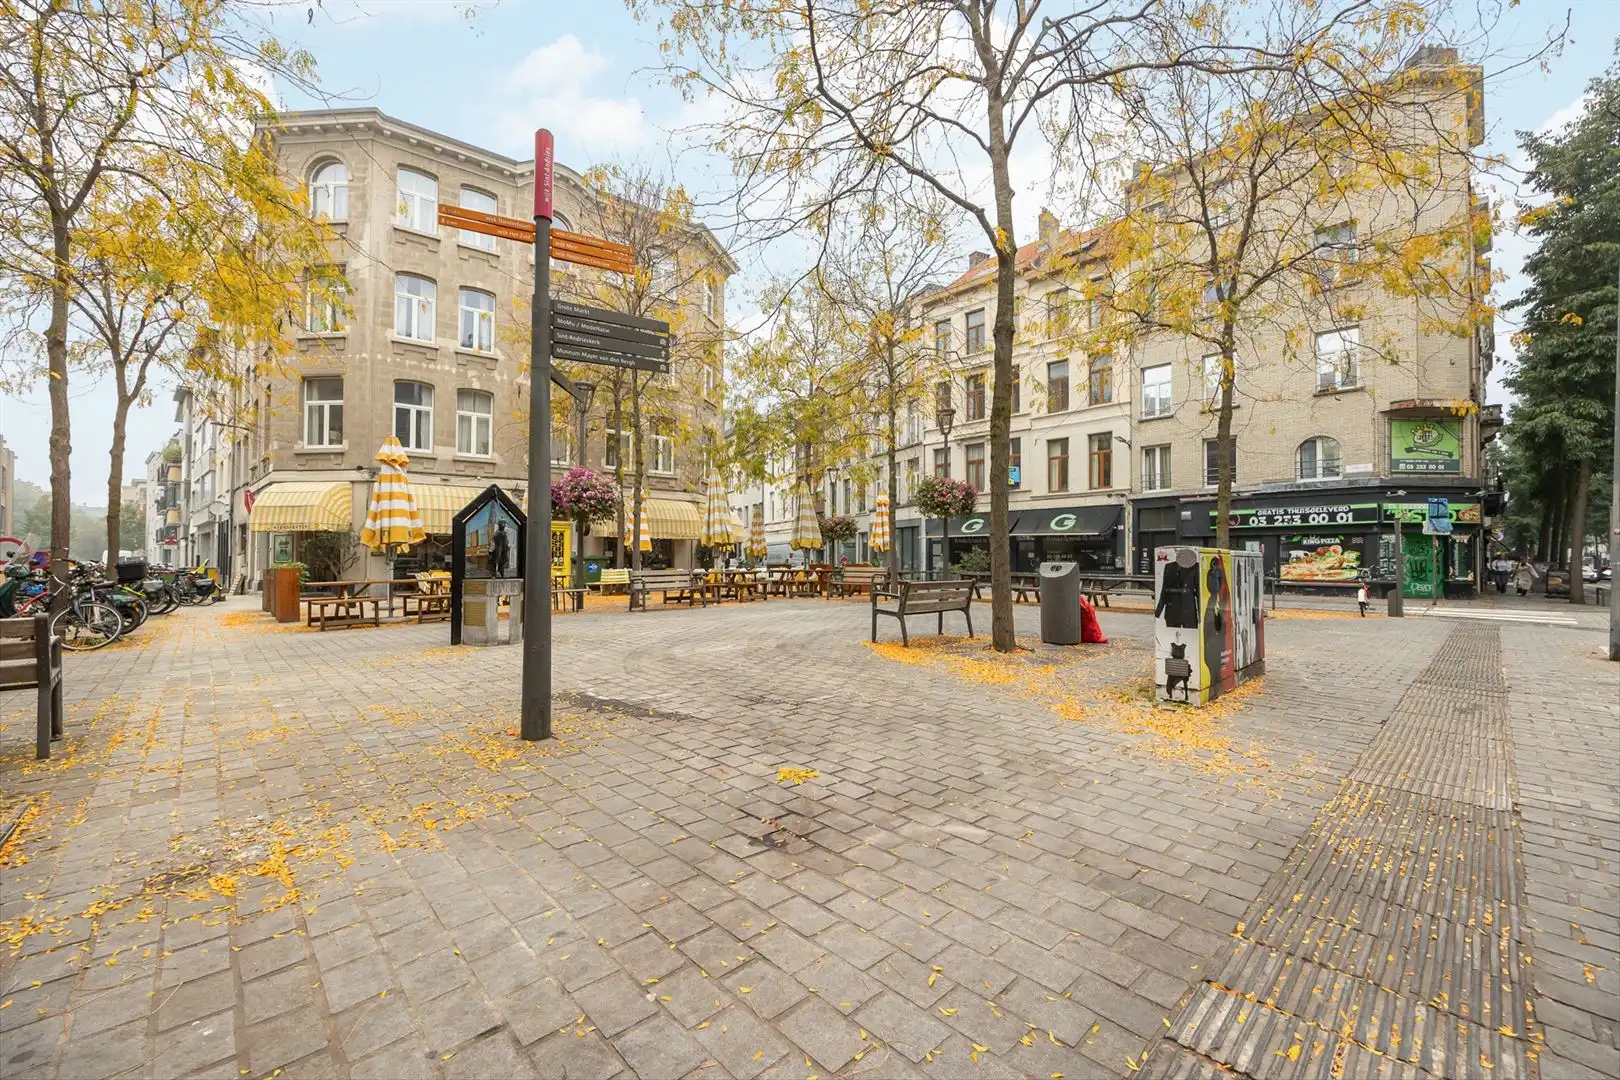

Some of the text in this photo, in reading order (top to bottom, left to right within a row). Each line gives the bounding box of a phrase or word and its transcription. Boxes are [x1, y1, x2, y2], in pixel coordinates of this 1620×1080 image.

[558, 304, 590, 315] Grote Markt
[558, 318, 576, 326] MoMu
[557, 348, 580, 356] Museum
[582, 352, 598, 360] Mayer
[1287, 506, 1350, 514] THUISGELEVERD
[961, 518, 984, 532] G
[1050, 514, 1076, 530] G
[1249, 512, 1353, 526] 03 233 00 01
